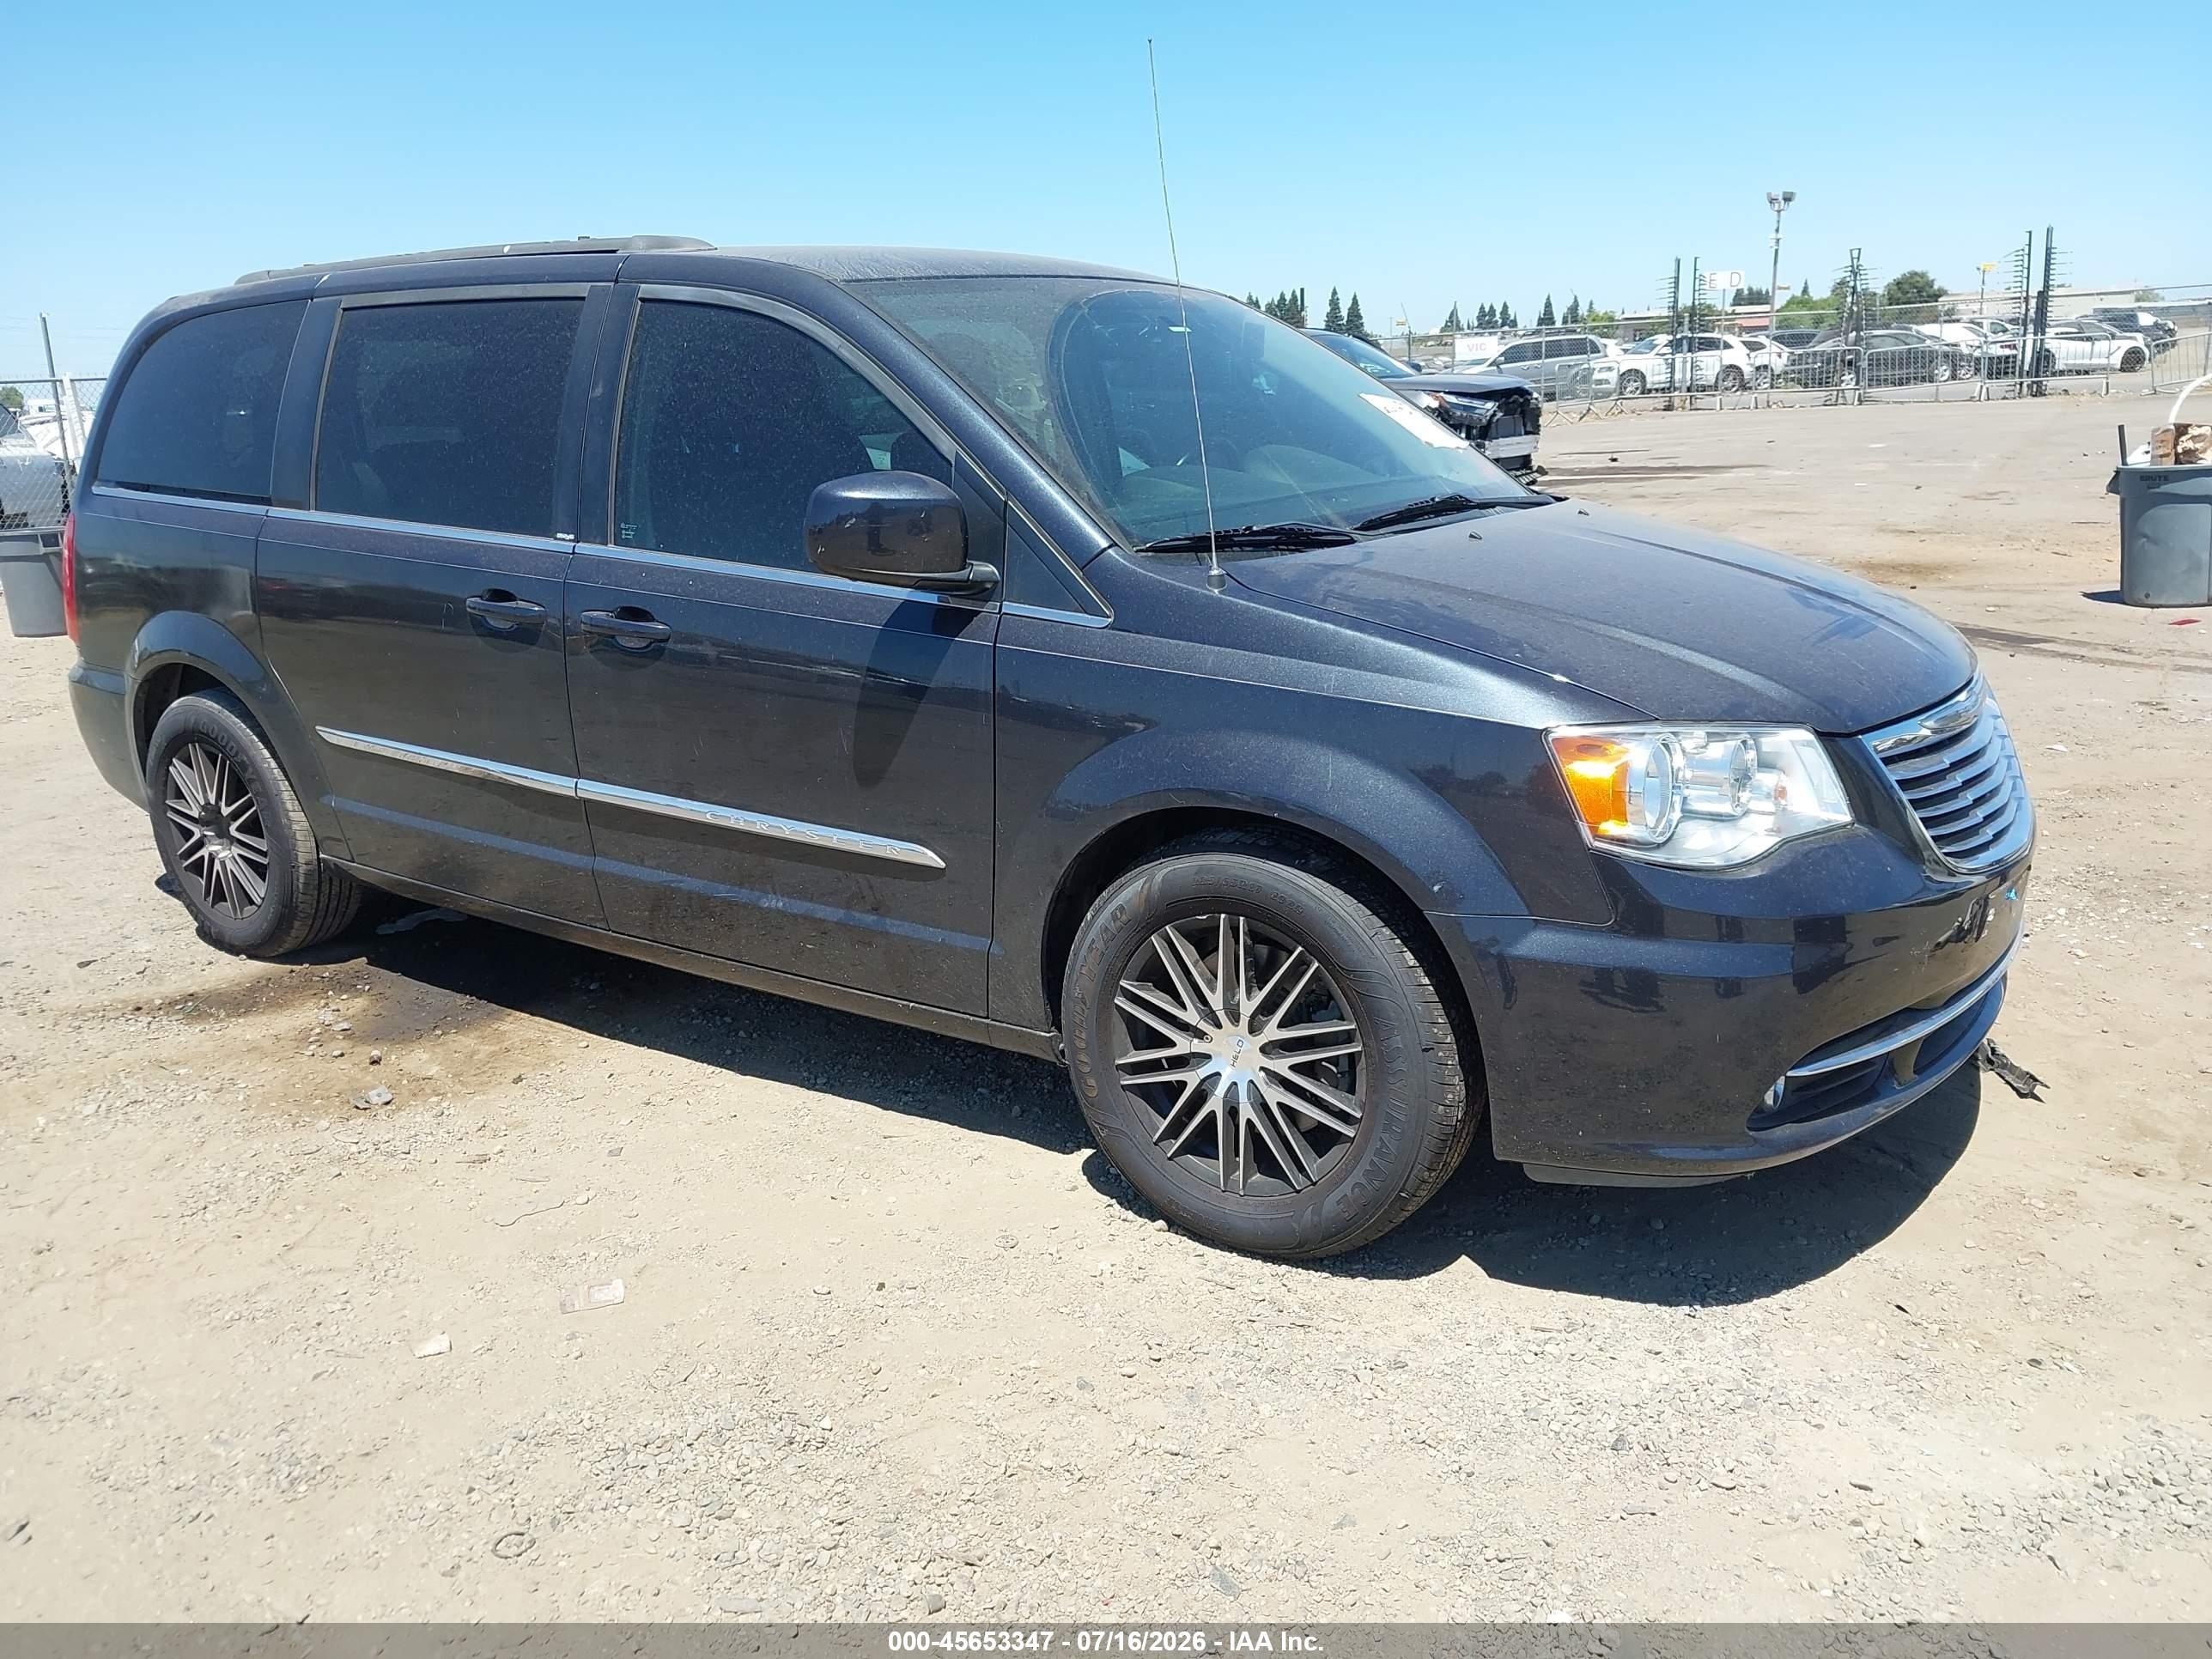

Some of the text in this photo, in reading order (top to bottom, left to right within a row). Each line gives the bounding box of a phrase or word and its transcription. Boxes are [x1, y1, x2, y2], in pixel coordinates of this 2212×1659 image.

[1467, 343, 1487, 353] VIC
[705, 810, 902, 855] CHRYSLER
[1336, 1015, 1409, 1224] ASSURANCE
